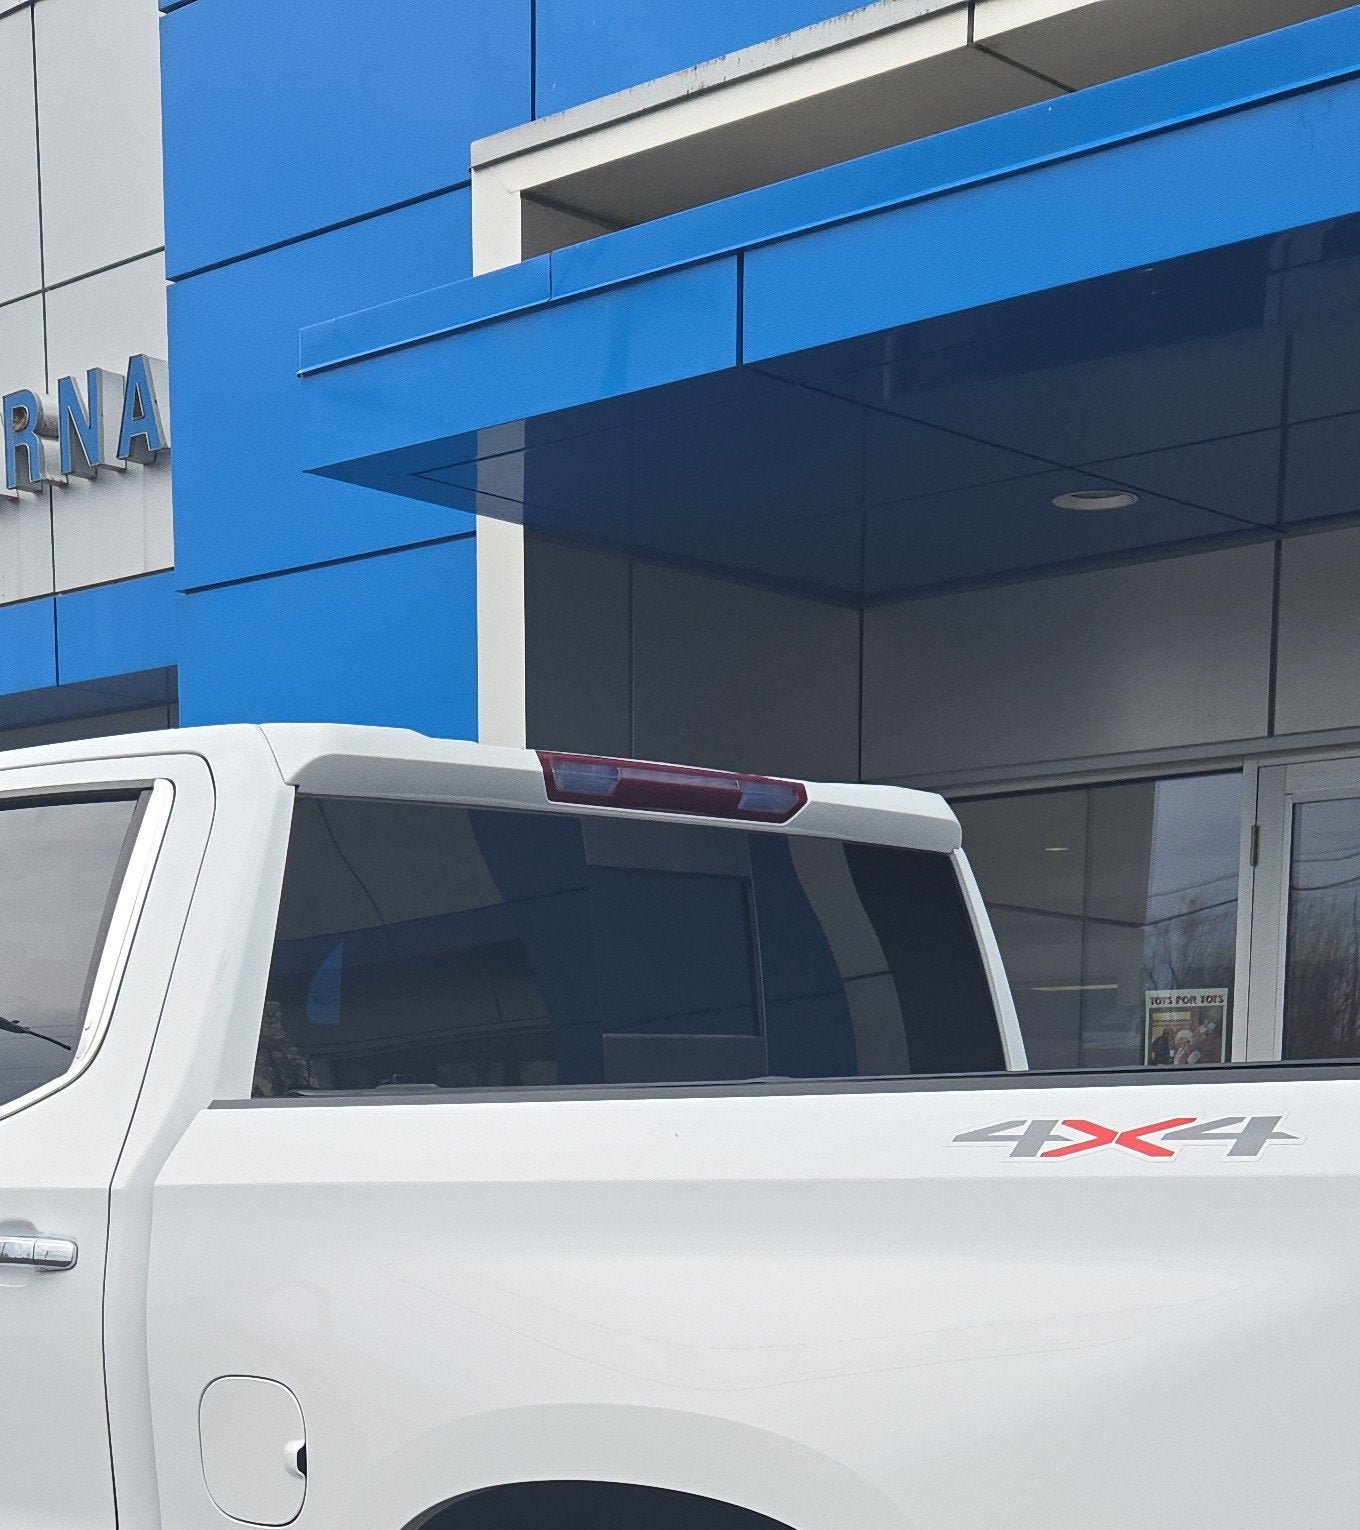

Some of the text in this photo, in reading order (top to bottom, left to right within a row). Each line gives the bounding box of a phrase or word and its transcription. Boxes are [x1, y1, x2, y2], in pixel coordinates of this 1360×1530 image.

[1149, 994, 1224, 1006] TOYS FOR TOTS
